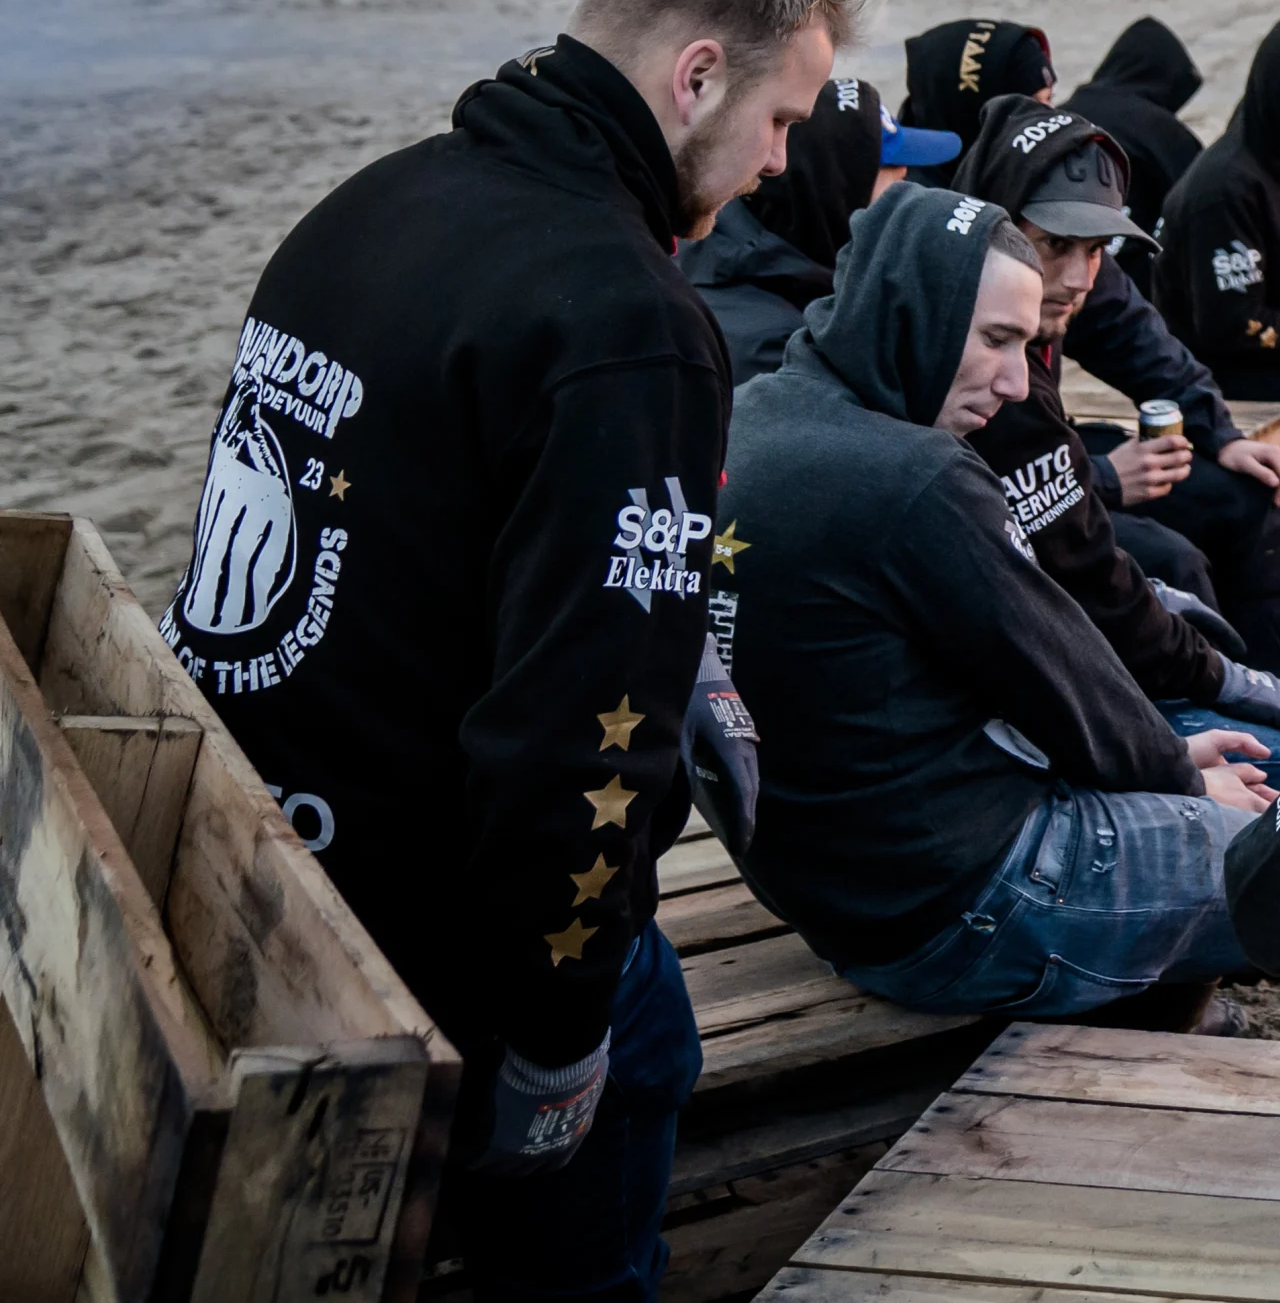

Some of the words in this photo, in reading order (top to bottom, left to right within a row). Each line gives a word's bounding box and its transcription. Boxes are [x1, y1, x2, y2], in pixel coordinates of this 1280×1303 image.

[299, 457, 325, 491] 23
[1000, 443, 1071, 501] AUTO
[613, 505, 712, 555] S&P
[1020, 485, 1085, 535] HEVENINGEN
[603, 555, 702, 595] Elektra
[213, 652, 282, 694] THE
[275, 527, 349, 678] LEGENDS
